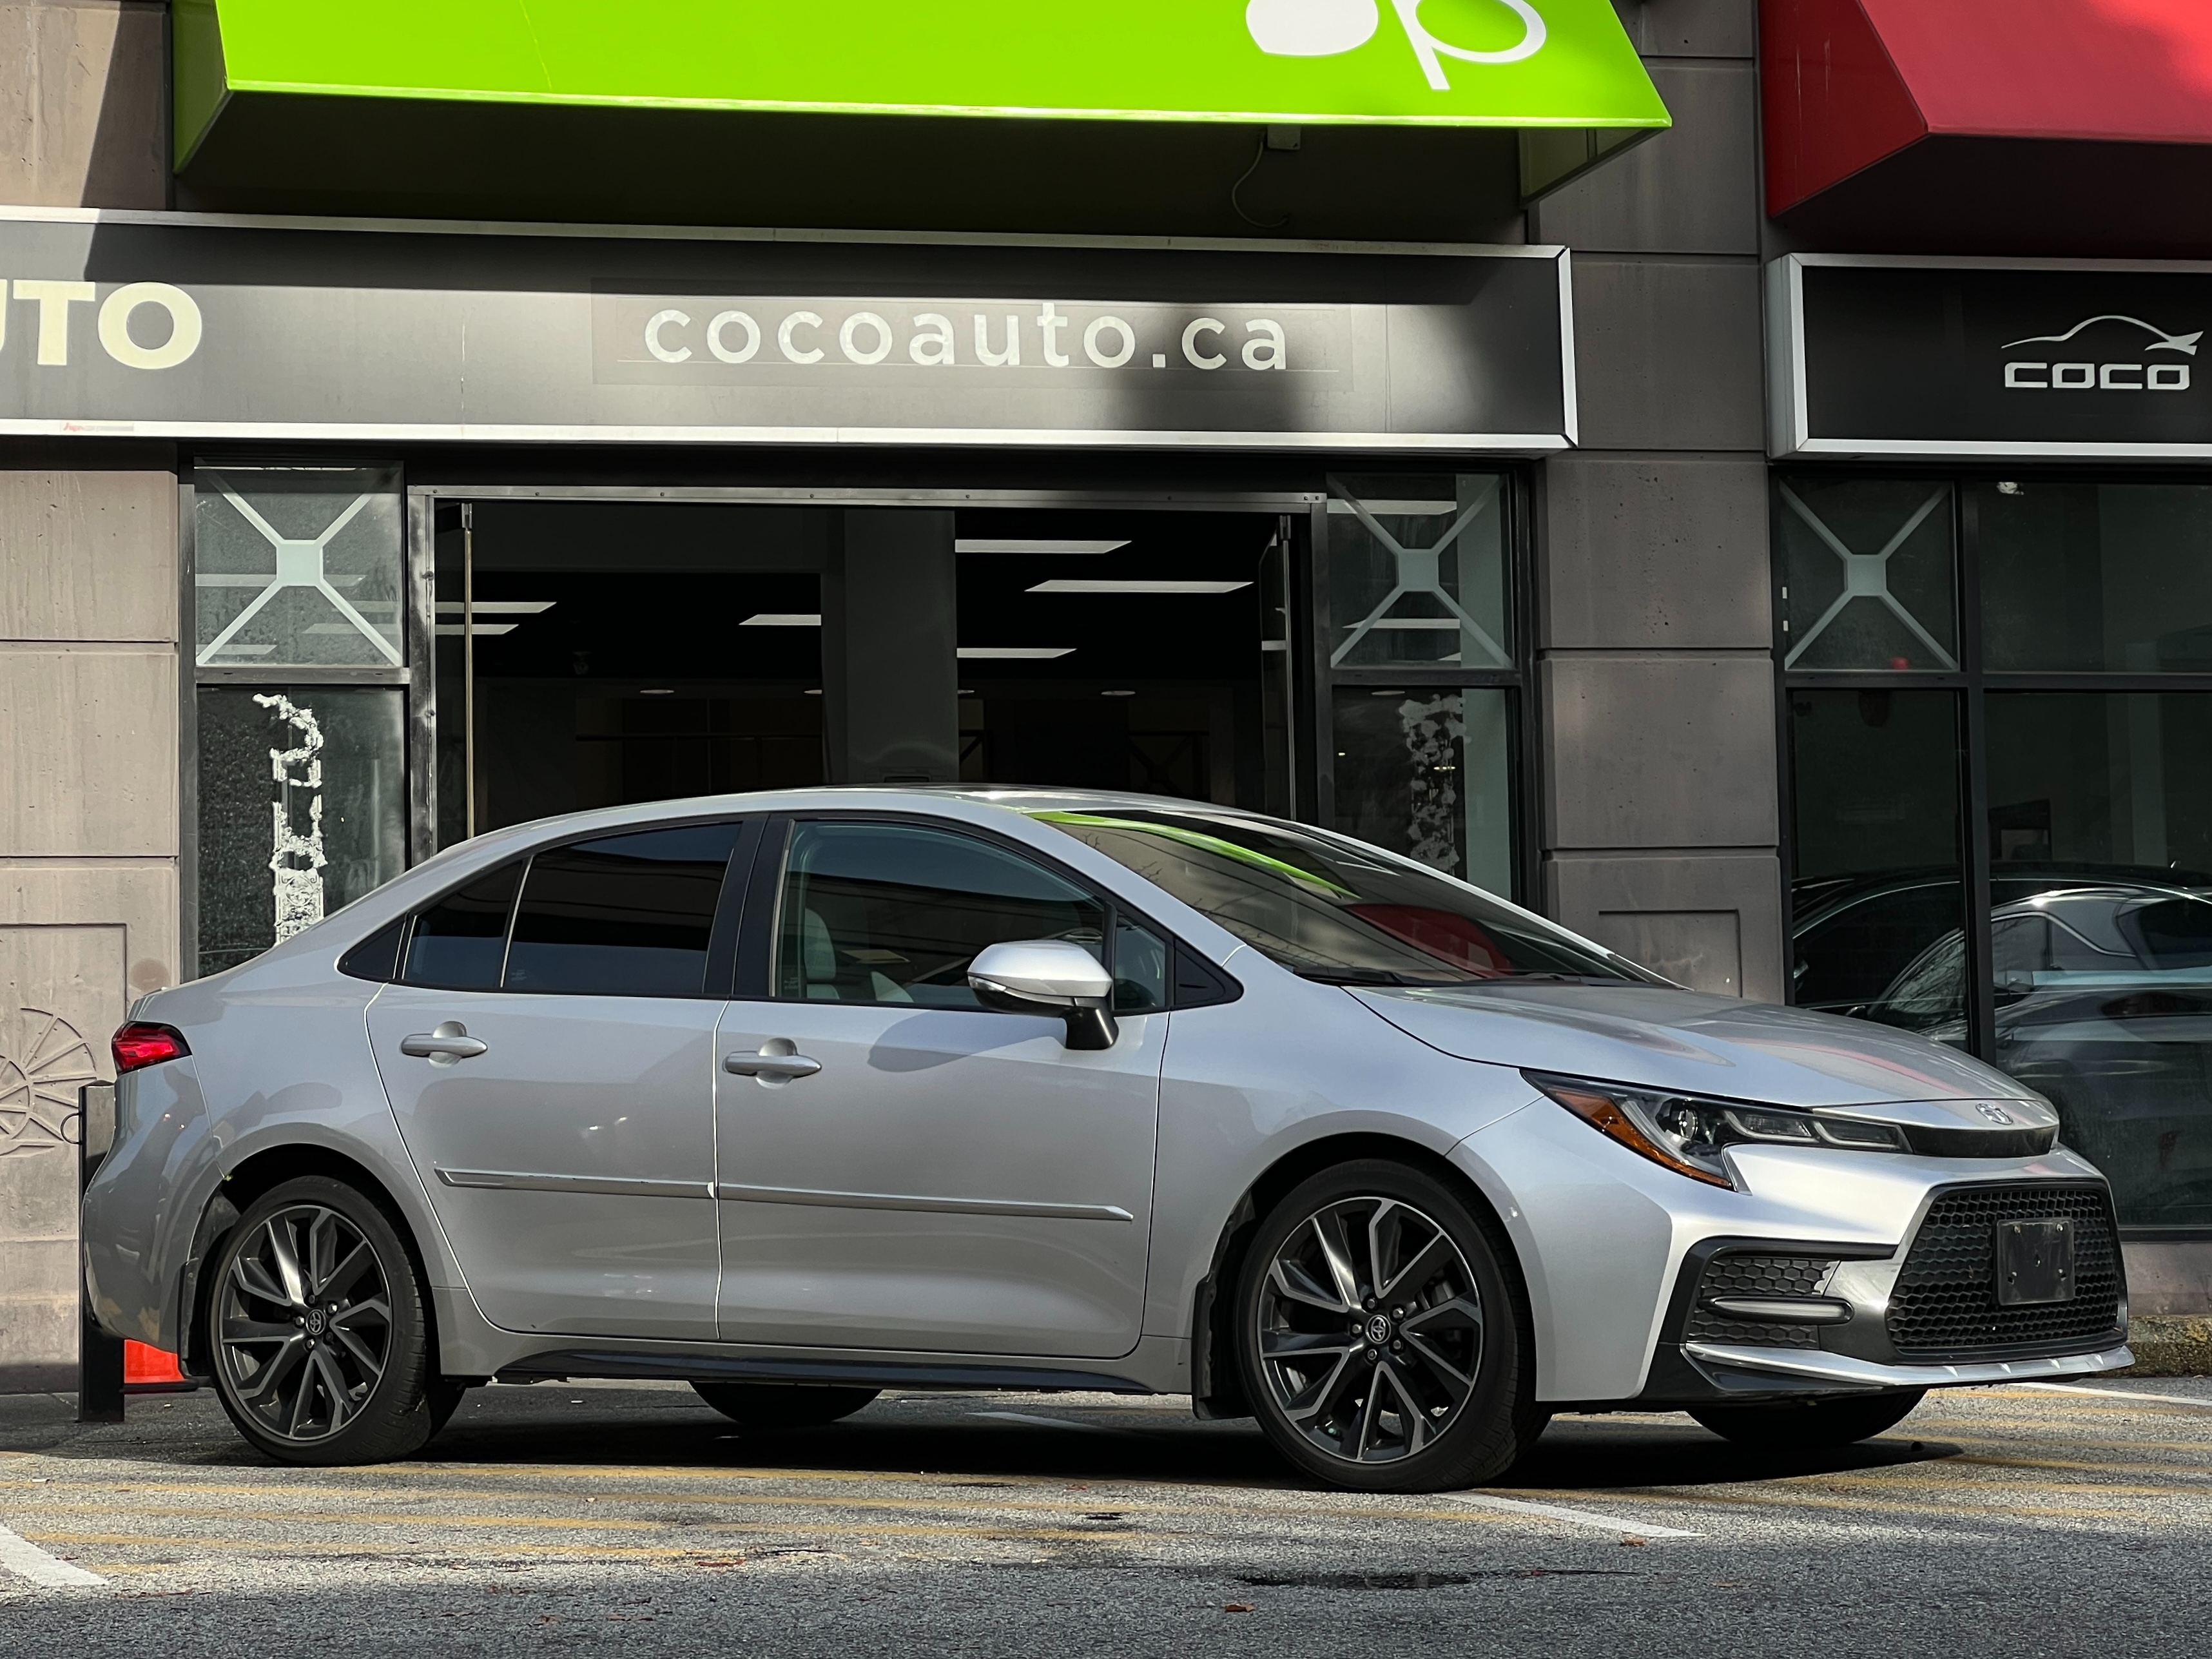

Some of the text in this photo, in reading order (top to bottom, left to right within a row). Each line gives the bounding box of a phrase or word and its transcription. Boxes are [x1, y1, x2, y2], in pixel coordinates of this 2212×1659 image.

[0, 279, 202, 369] TO
[643, 302, 1288, 372] cocoauto.ca
[2004, 362, 2190, 391] COCO
